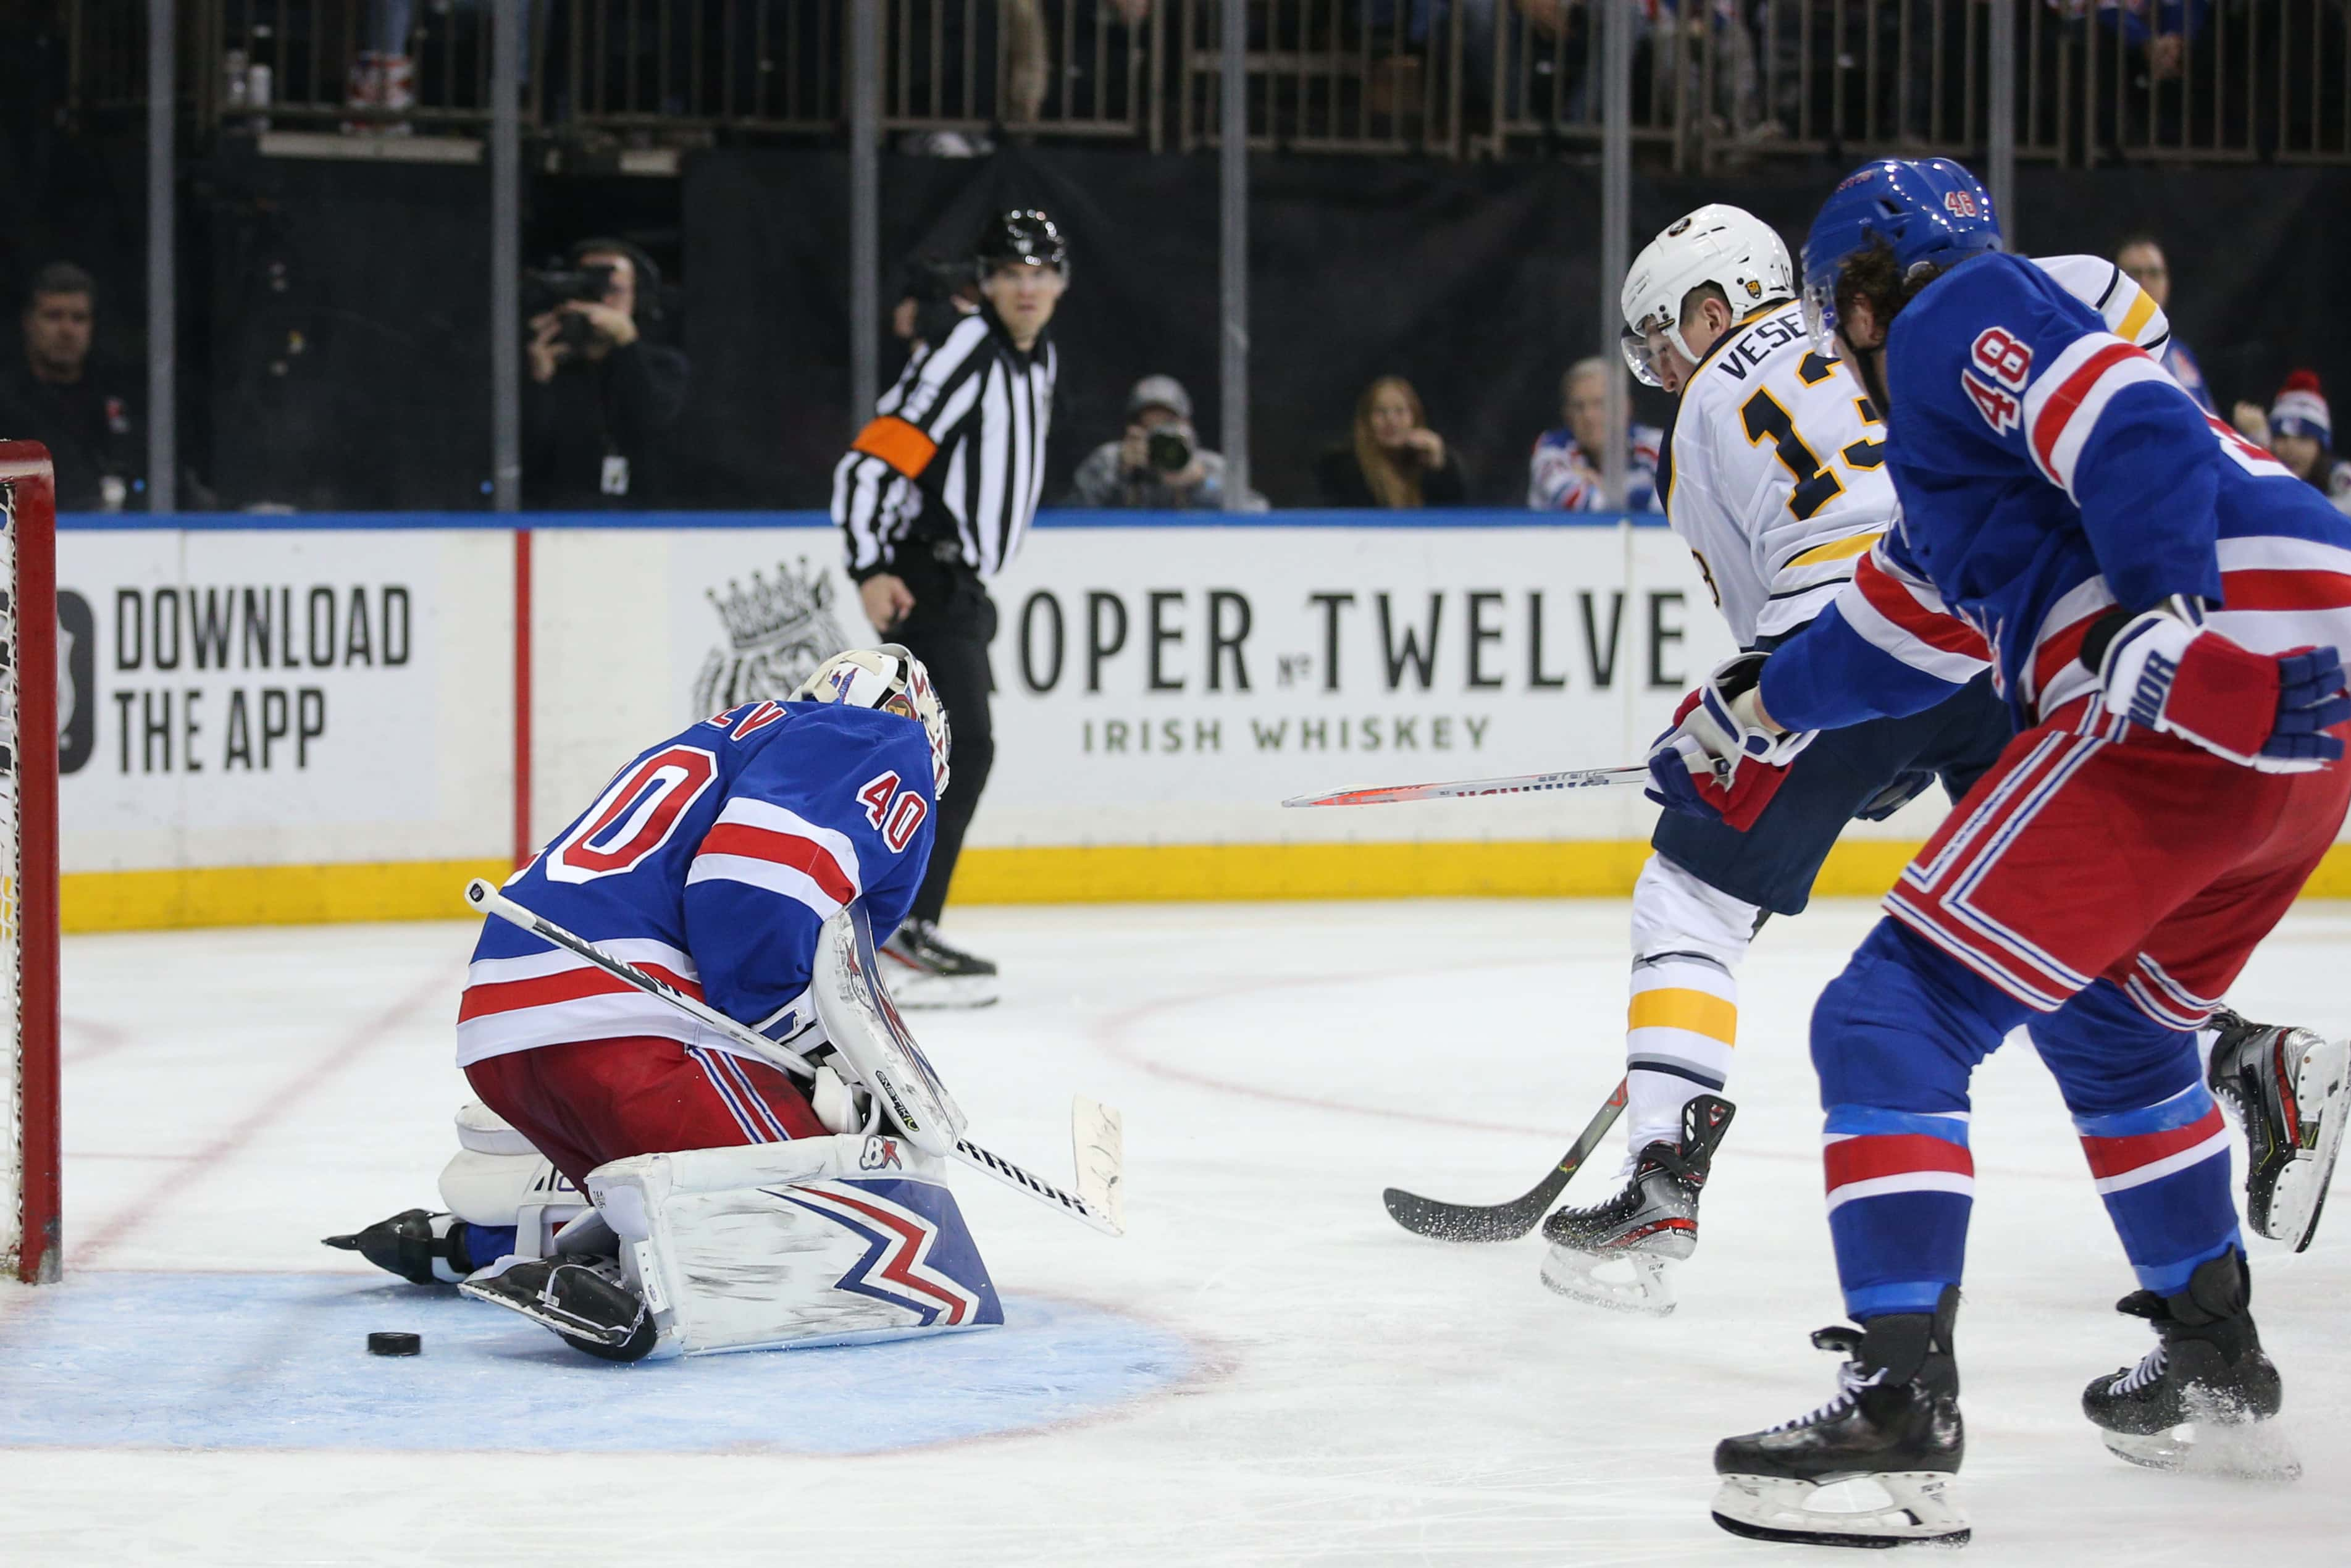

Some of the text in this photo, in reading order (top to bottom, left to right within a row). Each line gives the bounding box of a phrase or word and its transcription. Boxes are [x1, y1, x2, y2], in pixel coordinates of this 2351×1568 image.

[1718, 311, 1808, 380] VESE
[1960, 325, 2035, 437] 48
[115, 586, 411, 671] DOWNLOAD
[1308, 590, 1685, 691] TWELVE
[114, 687, 325, 774] THE APP
[1082, 716, 1490, 753] IRISH WHISKEY
[539, 744, 719, 885] 0
[855, 769, 928, 854] 40
